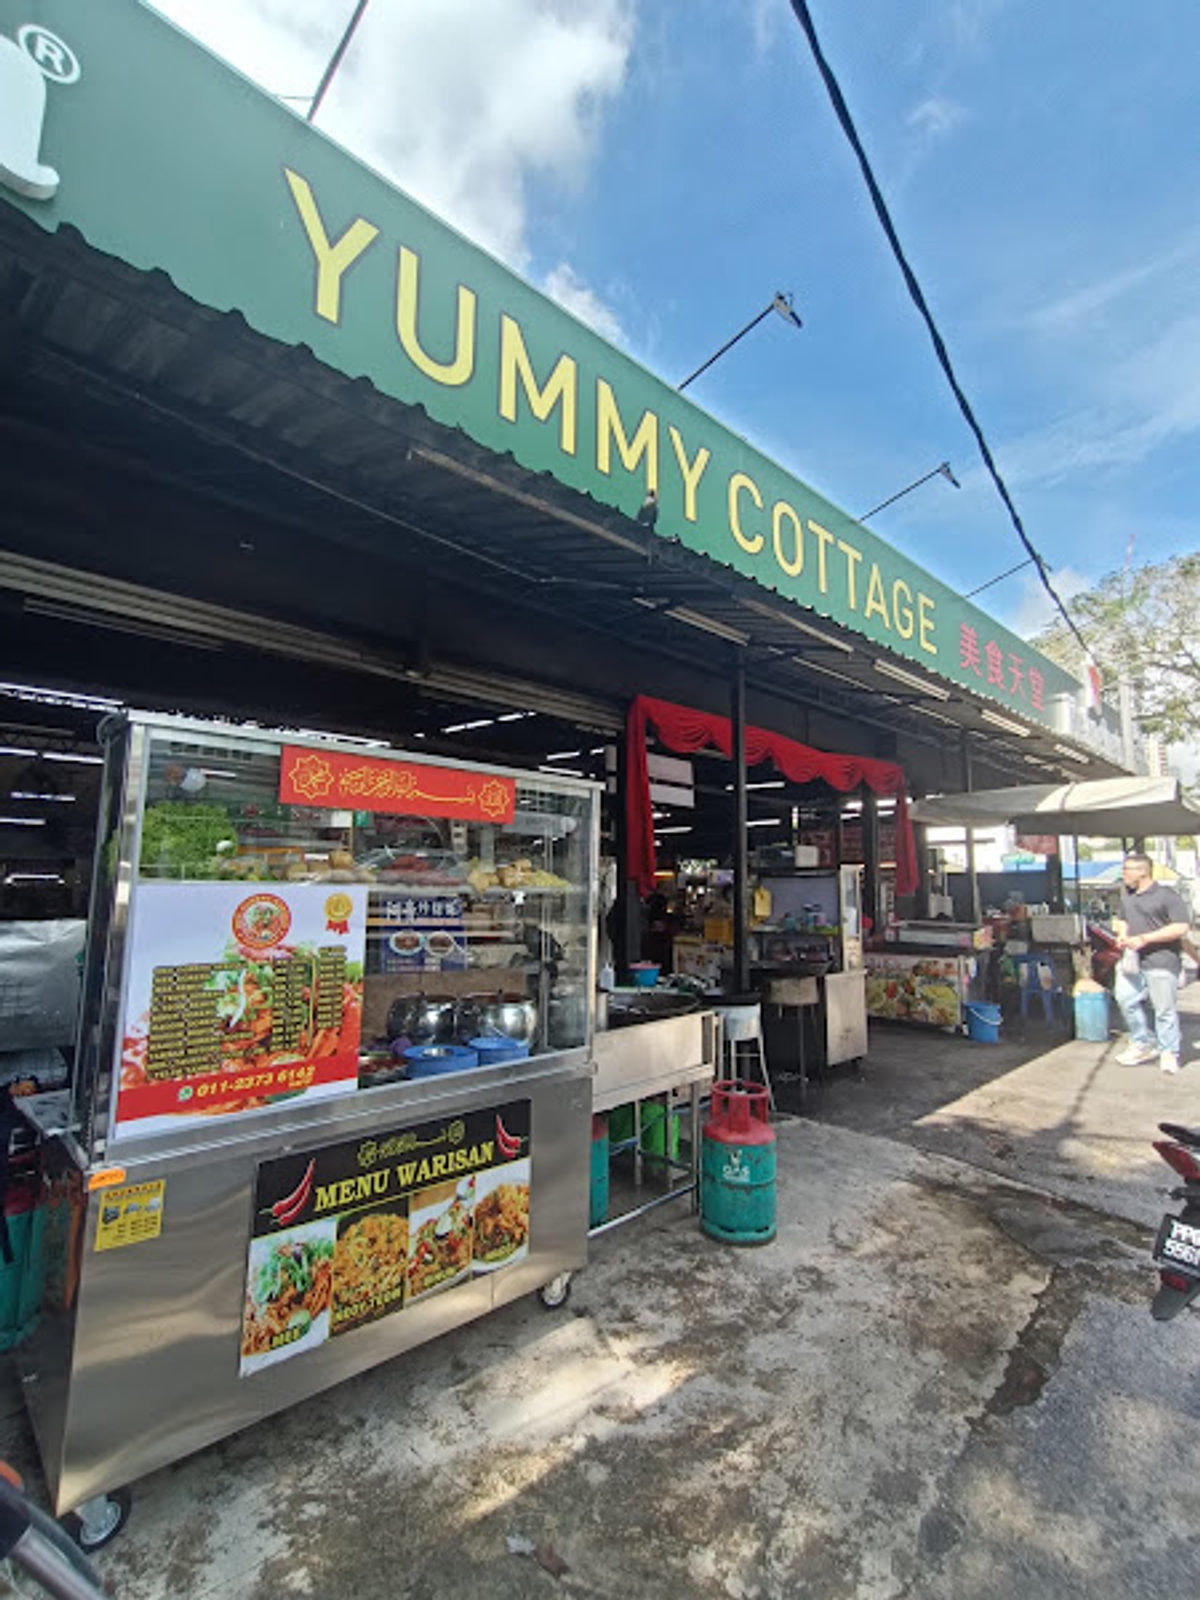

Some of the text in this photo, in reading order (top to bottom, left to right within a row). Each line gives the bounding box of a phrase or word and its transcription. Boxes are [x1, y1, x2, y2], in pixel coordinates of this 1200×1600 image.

[284, 167, 938, 655] YUMMY COTTAGE
[960, 622, 1045, 712] 美食天堂
[313, 1168, 390, 1212] MENU
[397, 1140, 495, 1188] WARISAN
